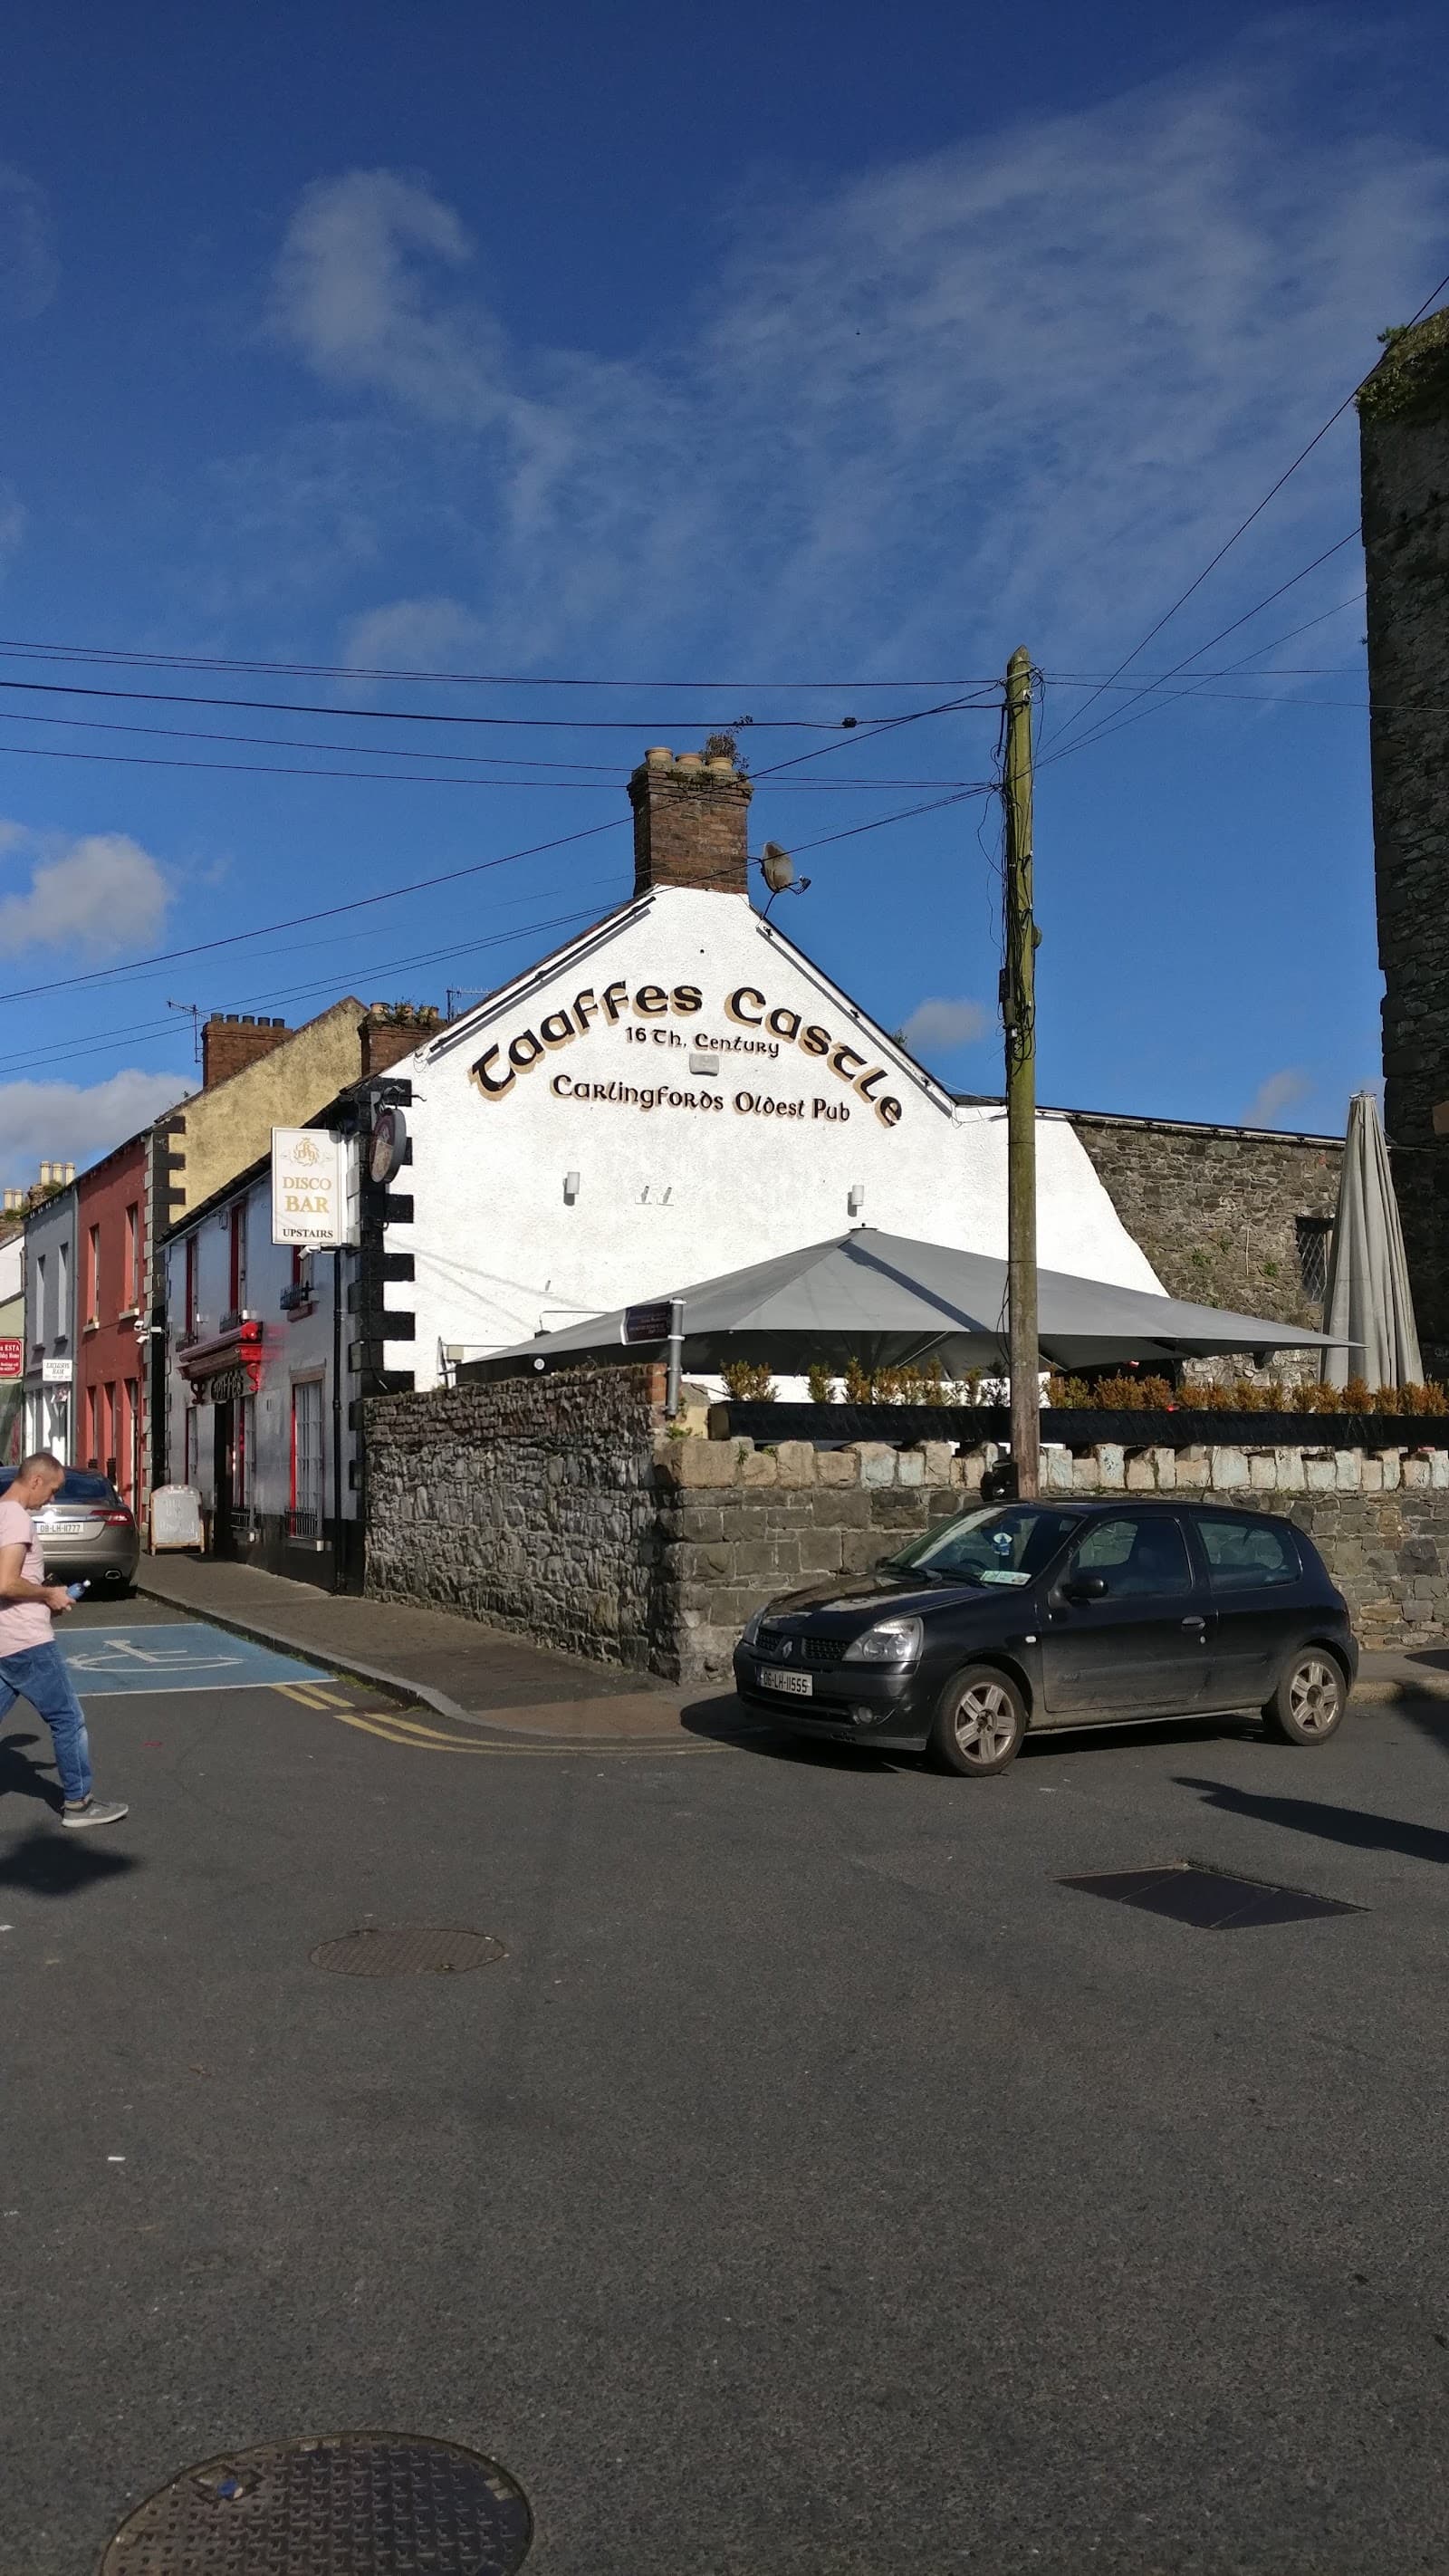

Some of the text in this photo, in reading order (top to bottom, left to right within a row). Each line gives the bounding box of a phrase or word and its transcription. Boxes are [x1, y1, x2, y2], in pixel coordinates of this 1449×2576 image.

[626, 1026, 647, 1043] 16
[695, 1033, 780, 1058] Century
[468, 980, 903, 1129] Taaffes Castle
[552, 1074, 850, 1122] Carlingfords Oldest Pub
[283, 1177, 332, 1191] DISCO
[284, 1196, 330, 1214] BAR
[283, 1228, 334, 1238] UPSTAIRS
[763, 1671, 808, 1693] 06-LH-11555
